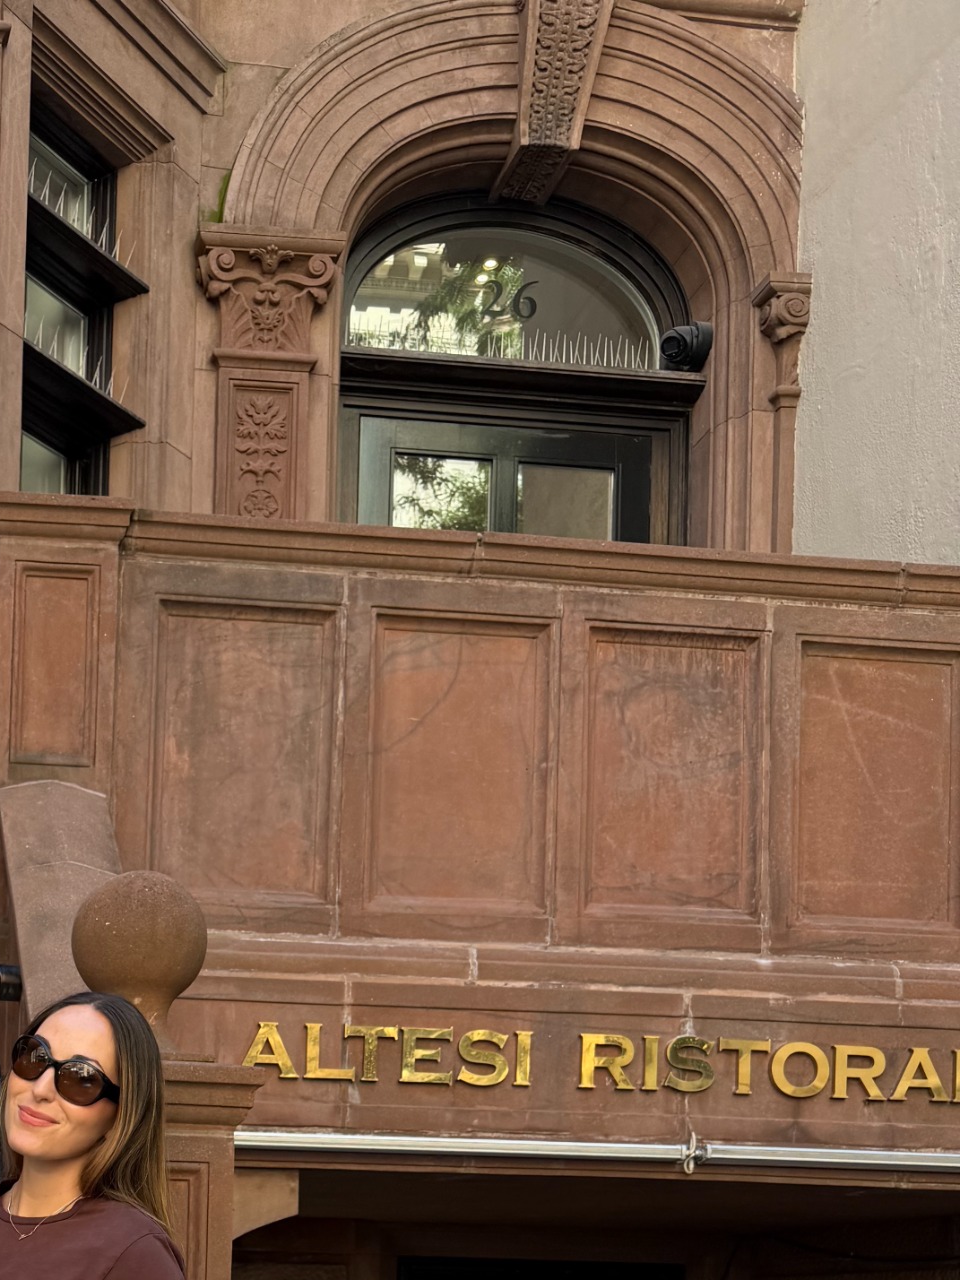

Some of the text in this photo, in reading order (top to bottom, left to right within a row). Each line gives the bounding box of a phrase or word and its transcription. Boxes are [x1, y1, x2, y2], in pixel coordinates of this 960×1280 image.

[480, 280, 539, 319] 26
[242, 1021, 960, 1103] ALTESI RISTORA
